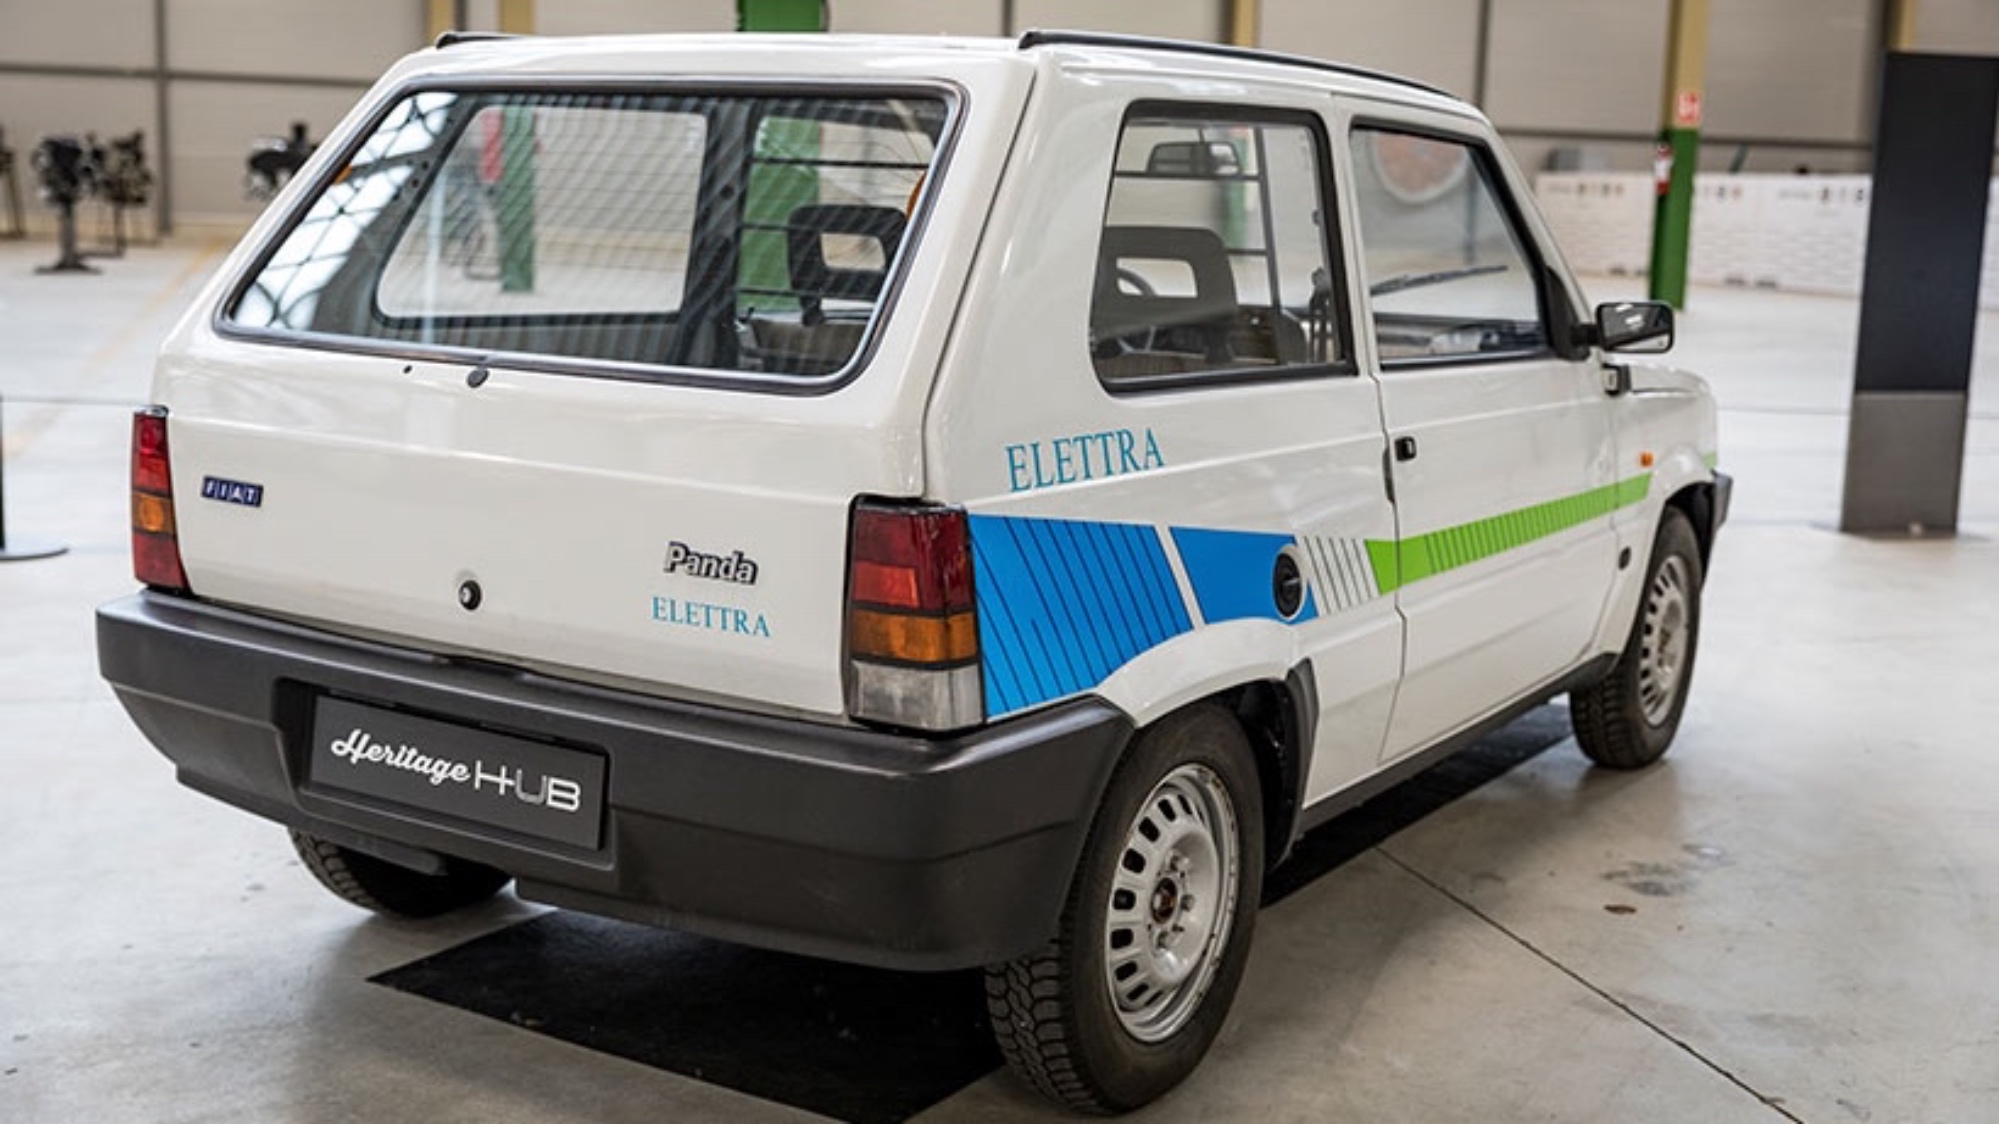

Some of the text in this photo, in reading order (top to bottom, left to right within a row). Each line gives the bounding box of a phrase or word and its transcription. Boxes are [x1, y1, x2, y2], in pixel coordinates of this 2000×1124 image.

[1005, 427, 1165, 492] ELETTRA
[205, 478, 257, 503] FIAT
[664, 540, 758, 585] Panda
[652, 597, 770, 638] ELETTRA
[331, 728, 581, 811] Heritage HUB
